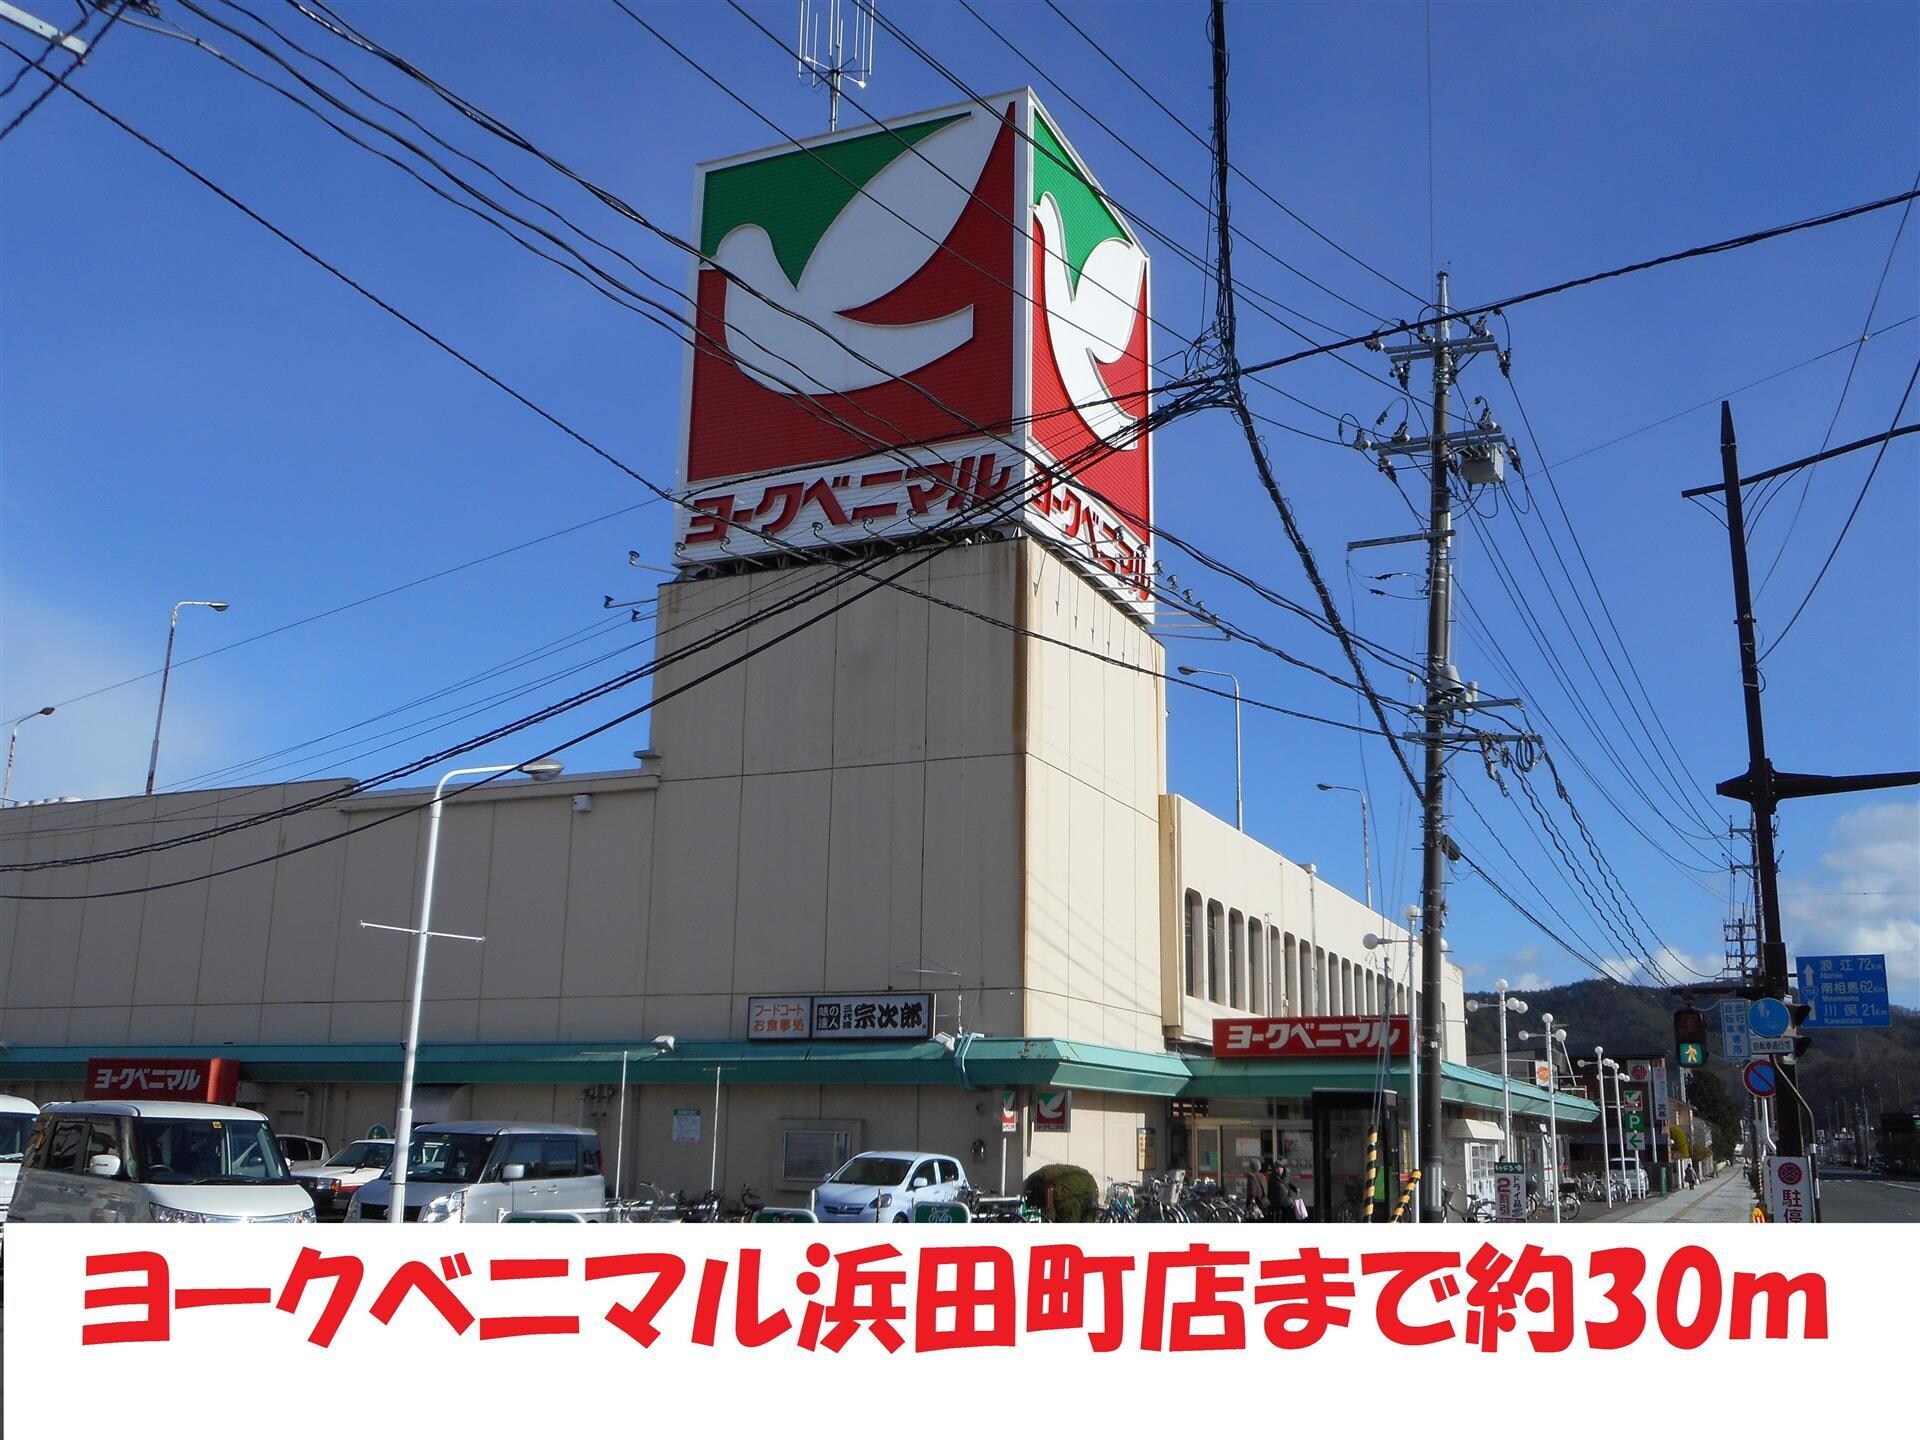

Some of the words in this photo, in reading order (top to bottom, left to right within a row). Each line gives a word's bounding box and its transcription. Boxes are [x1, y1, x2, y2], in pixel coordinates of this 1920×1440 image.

[685, 453, 1012, 545] ヨークベニマル
[1030, 463, 1150, 601] ヨークベニマル
[1821, 982, 1859, 994] 南相馬
[754, 1003, 805, 1017] フードコート
[854, 1003, 924, 1029] 宗次郎
[753, 1018, 805, 1032] お食事処
[1226, 1022, 1400, 1049] ヨークベニマル
[94, 1068, 201, 1091] ヨークベニマル
[1629, 1115, 1640, 1129] P
